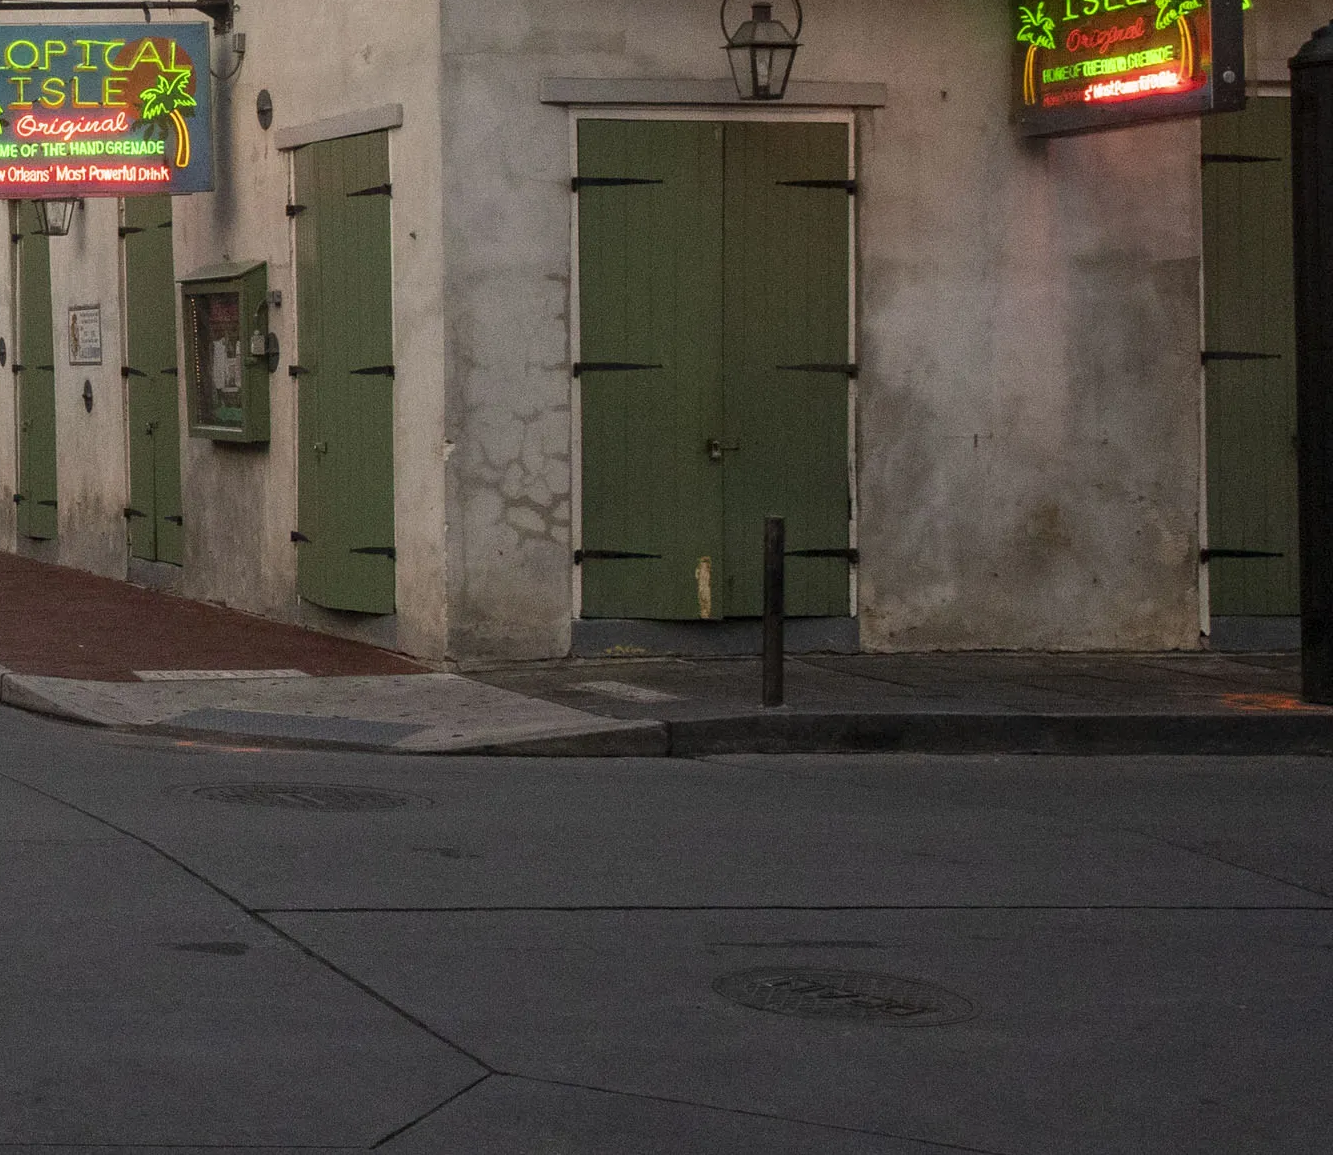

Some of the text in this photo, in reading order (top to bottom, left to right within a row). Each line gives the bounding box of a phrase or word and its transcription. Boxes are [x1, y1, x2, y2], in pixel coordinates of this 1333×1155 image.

[1066, 17, 1146, 54] Original
[8, 77, 128, 109] ISLE
[16, 112, 128, 141] Original
[20, 143, 39, 157] OF
[41, 142, 67, 156] THE
[7, 166, 53, 183] Orleans'
[56, 165, 87, 181] Most
[89, 165, 137, 182] Powerful
[138, 166, 170, 181] Drink
